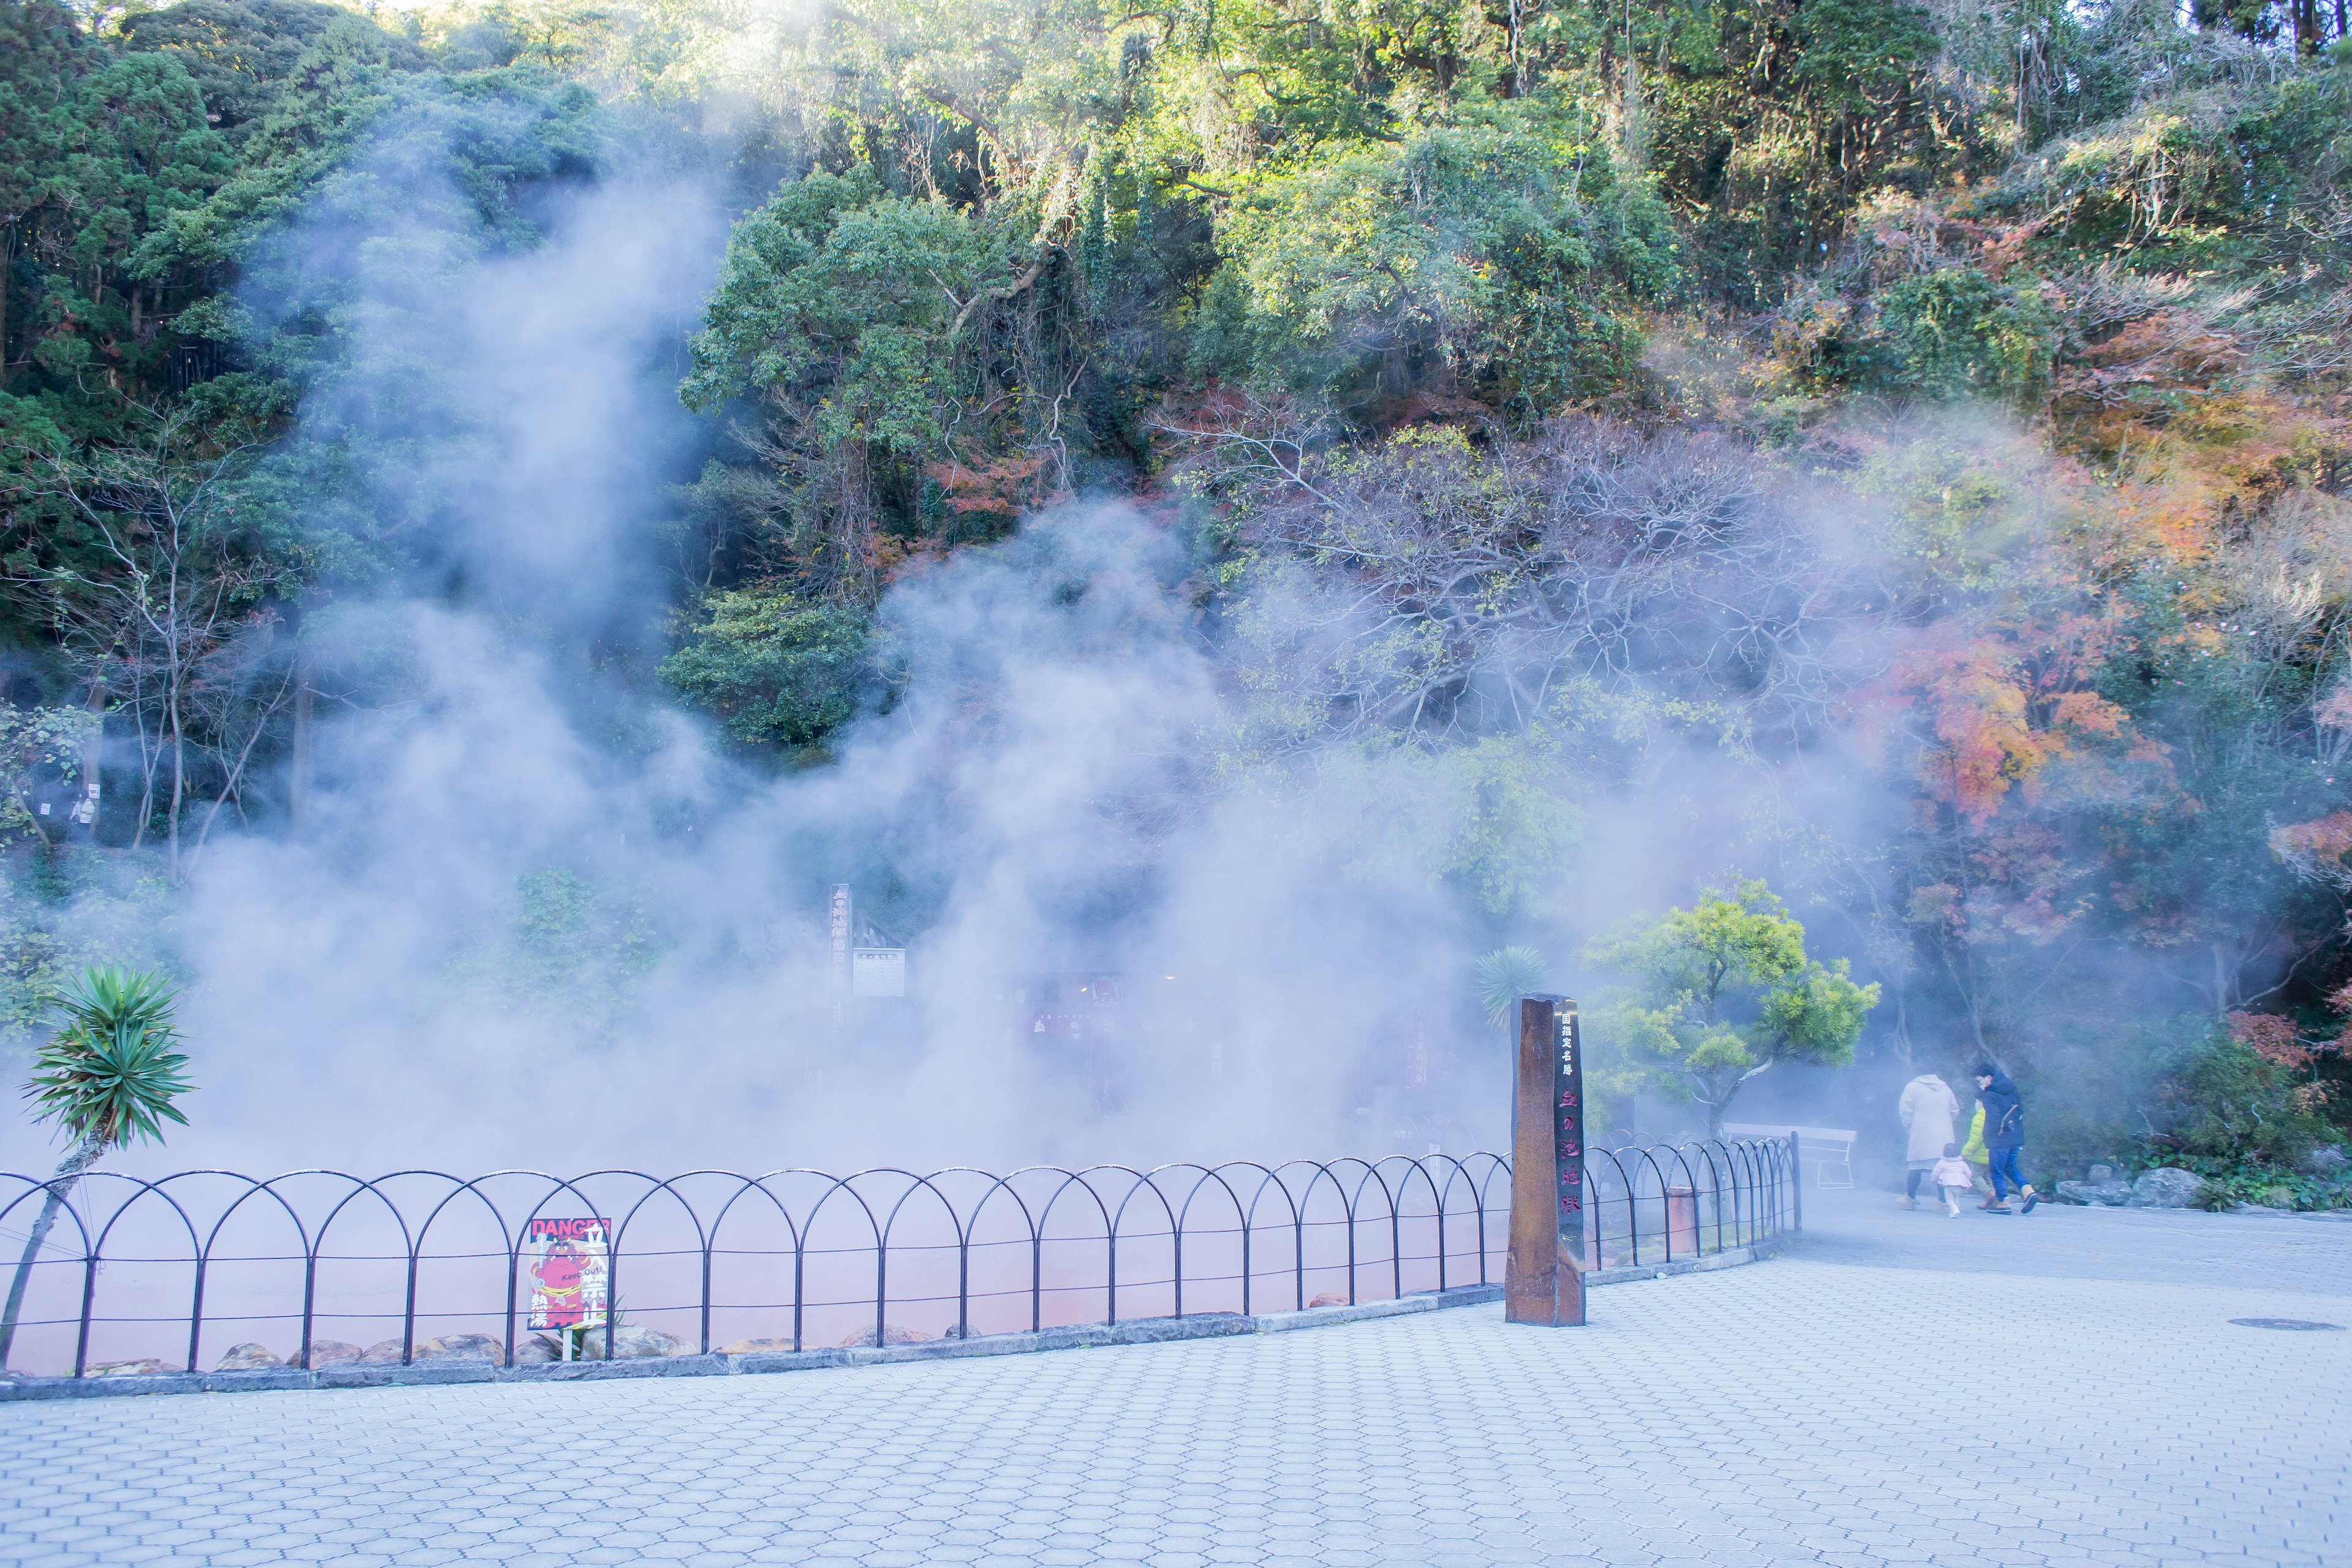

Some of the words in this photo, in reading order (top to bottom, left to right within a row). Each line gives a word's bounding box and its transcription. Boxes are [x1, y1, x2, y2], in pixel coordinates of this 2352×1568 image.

[1562, 1014, 1573, 1076] 国指定名勝
[1559, 1088, 1581, 1215] 血の池地獄
[532, 1220, 611, 1236] DANGER
[562, 1272, 582, 1281] Keep
[584, 1265, 603, 1276] Out!
[580, 1223, 608, 1325] 立入禁止
[530, 1294, 548, 1327] 熱湯
